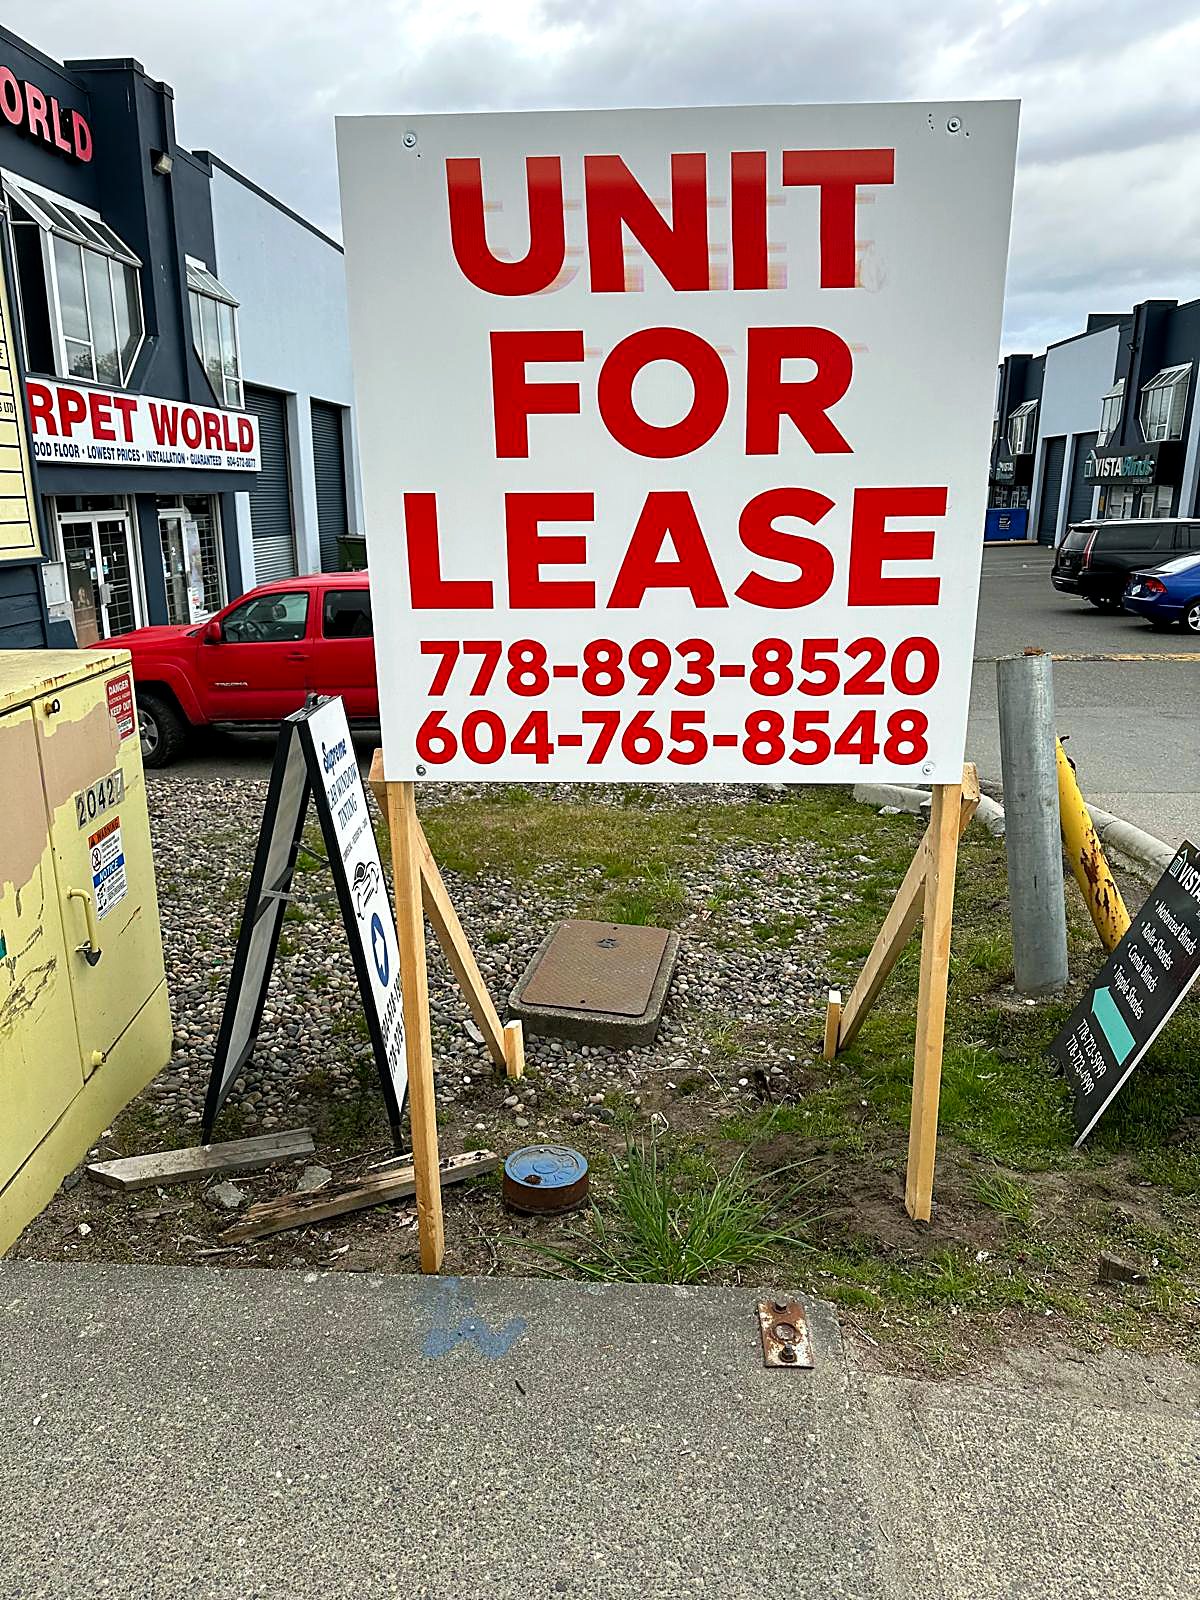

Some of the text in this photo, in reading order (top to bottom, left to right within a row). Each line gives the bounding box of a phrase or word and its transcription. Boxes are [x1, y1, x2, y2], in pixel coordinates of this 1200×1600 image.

[0, 66, 93, 162] ORLD
[445, 148, 896, 297] UNIT
[26, 382, 254, 453] RPET WORLD
[489, 327, 855, 459] FOR
[54, 443, 80, 458] FLOOR
[87, 445, 115, 460] LOWEST
[117, 447, 140, 462] PRICES
[146, 450, 186, 464] INSTALLATION
[190, 453, 222, 466] GUARANTEED
[403, 486, 949, 610] LEASE
[108, 680, 129, 696] DANGER
[420, 637, 940, 698] 778-893-8520
[415, 709, 930, 766] 604-765-8548
[335, 762, 358, 798] WINDOW
[338, 792, 358, 830] TINTING
[99, 858, 119, 883] NOTICE
[1141, 921, 1174, 970] Roller Shades
[1155, 900, 1198, 956] Motorized Blinds
[1128, 944, 1159, 993] Combi Blinds
[1126, 986, 1144, 1020] Shades
[1065, 1033, 1095, 1096] 778-723-4999
[1076, 1018, 1107, 1079] 778-723-5999
